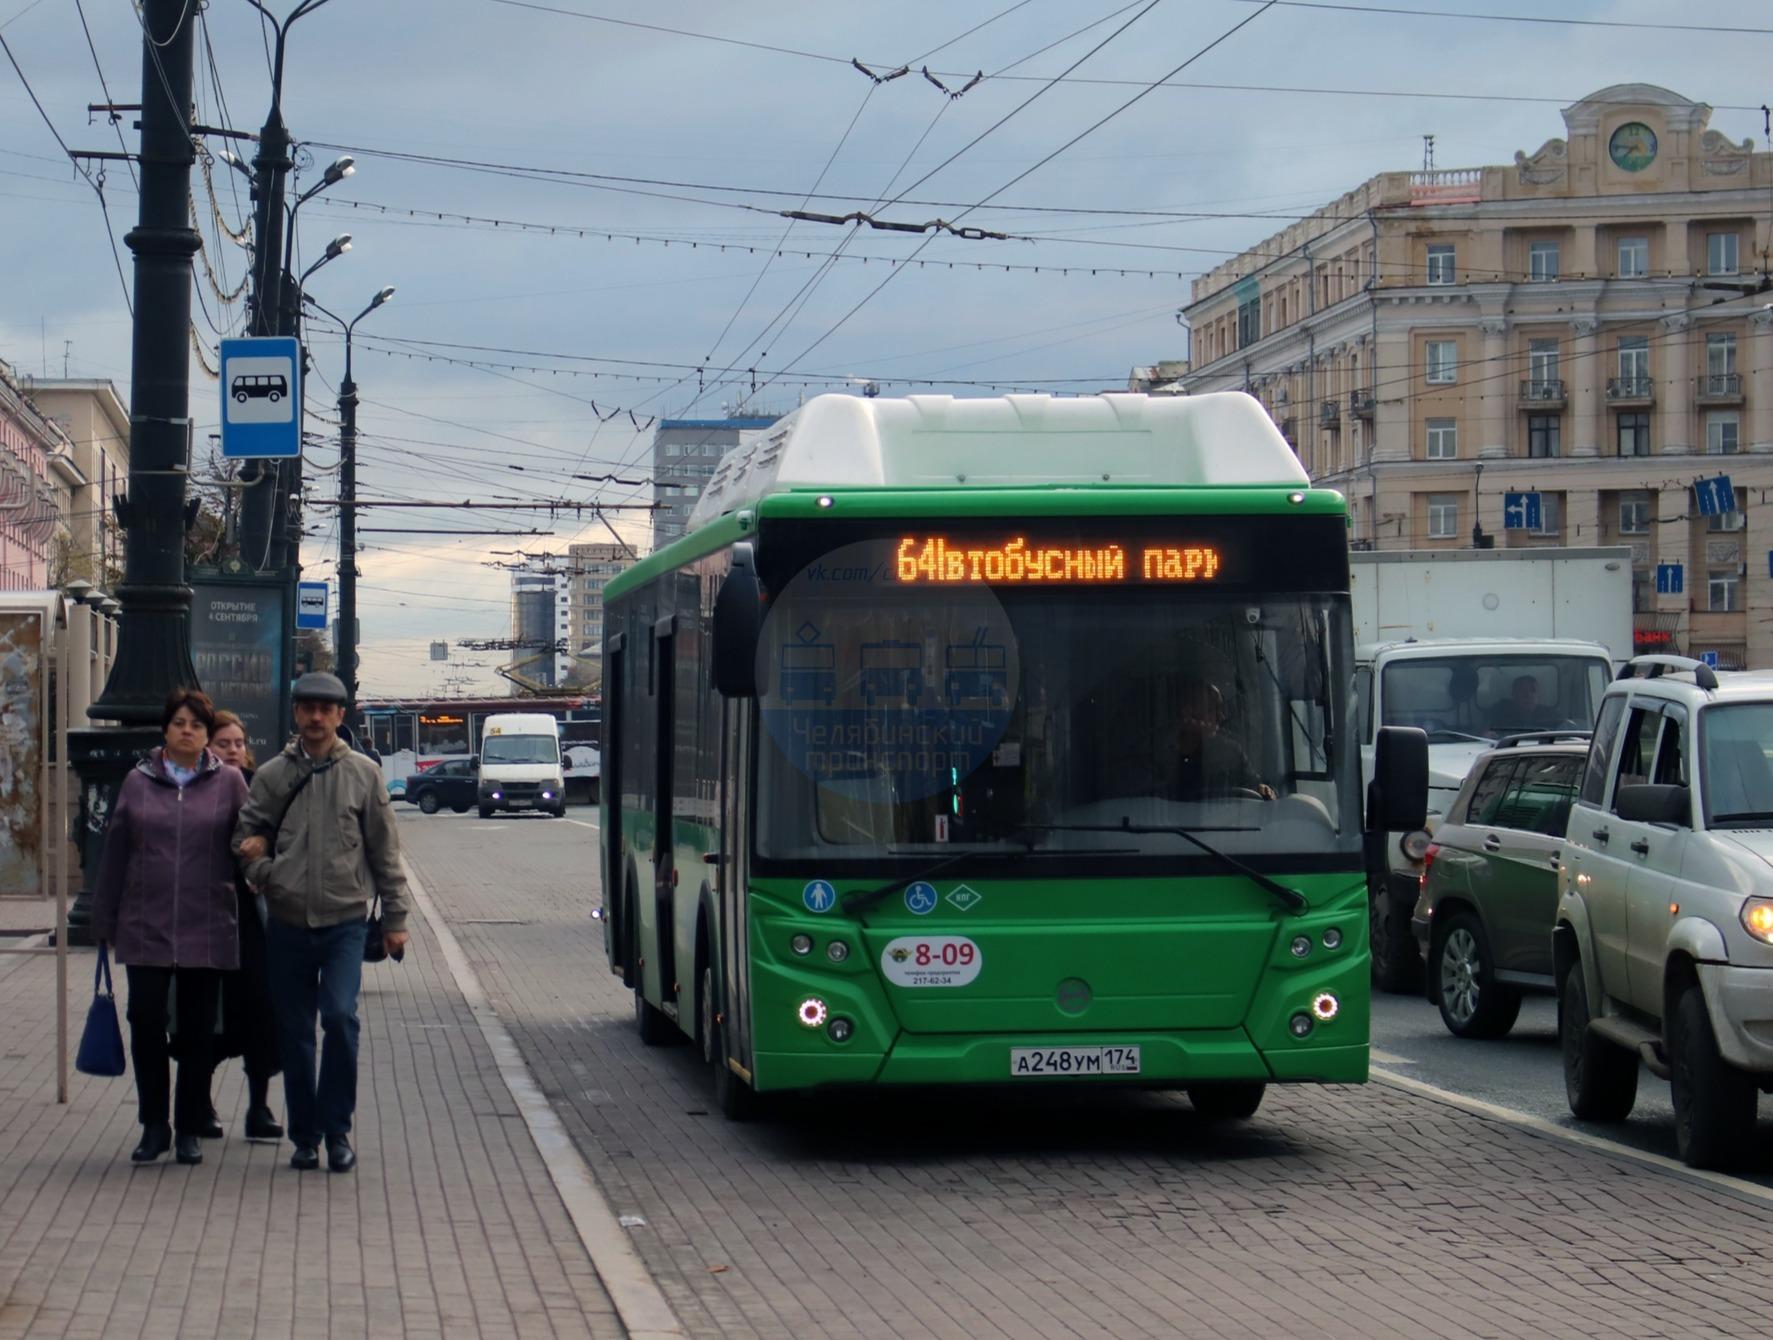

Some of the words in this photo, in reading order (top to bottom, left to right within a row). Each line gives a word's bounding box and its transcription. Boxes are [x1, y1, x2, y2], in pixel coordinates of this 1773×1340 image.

[210, 601, 257, 612] ОТКРЫТИЕ
[208, 612, 214, 621] 4
[215, 612, 259, 622] СЕНТЯБРЯ
[915, 943, 974, 966] 8-09
[1017, 1050, 1100, 1072] А248УМ
[1104, 1048, 1136, 1065] 174
